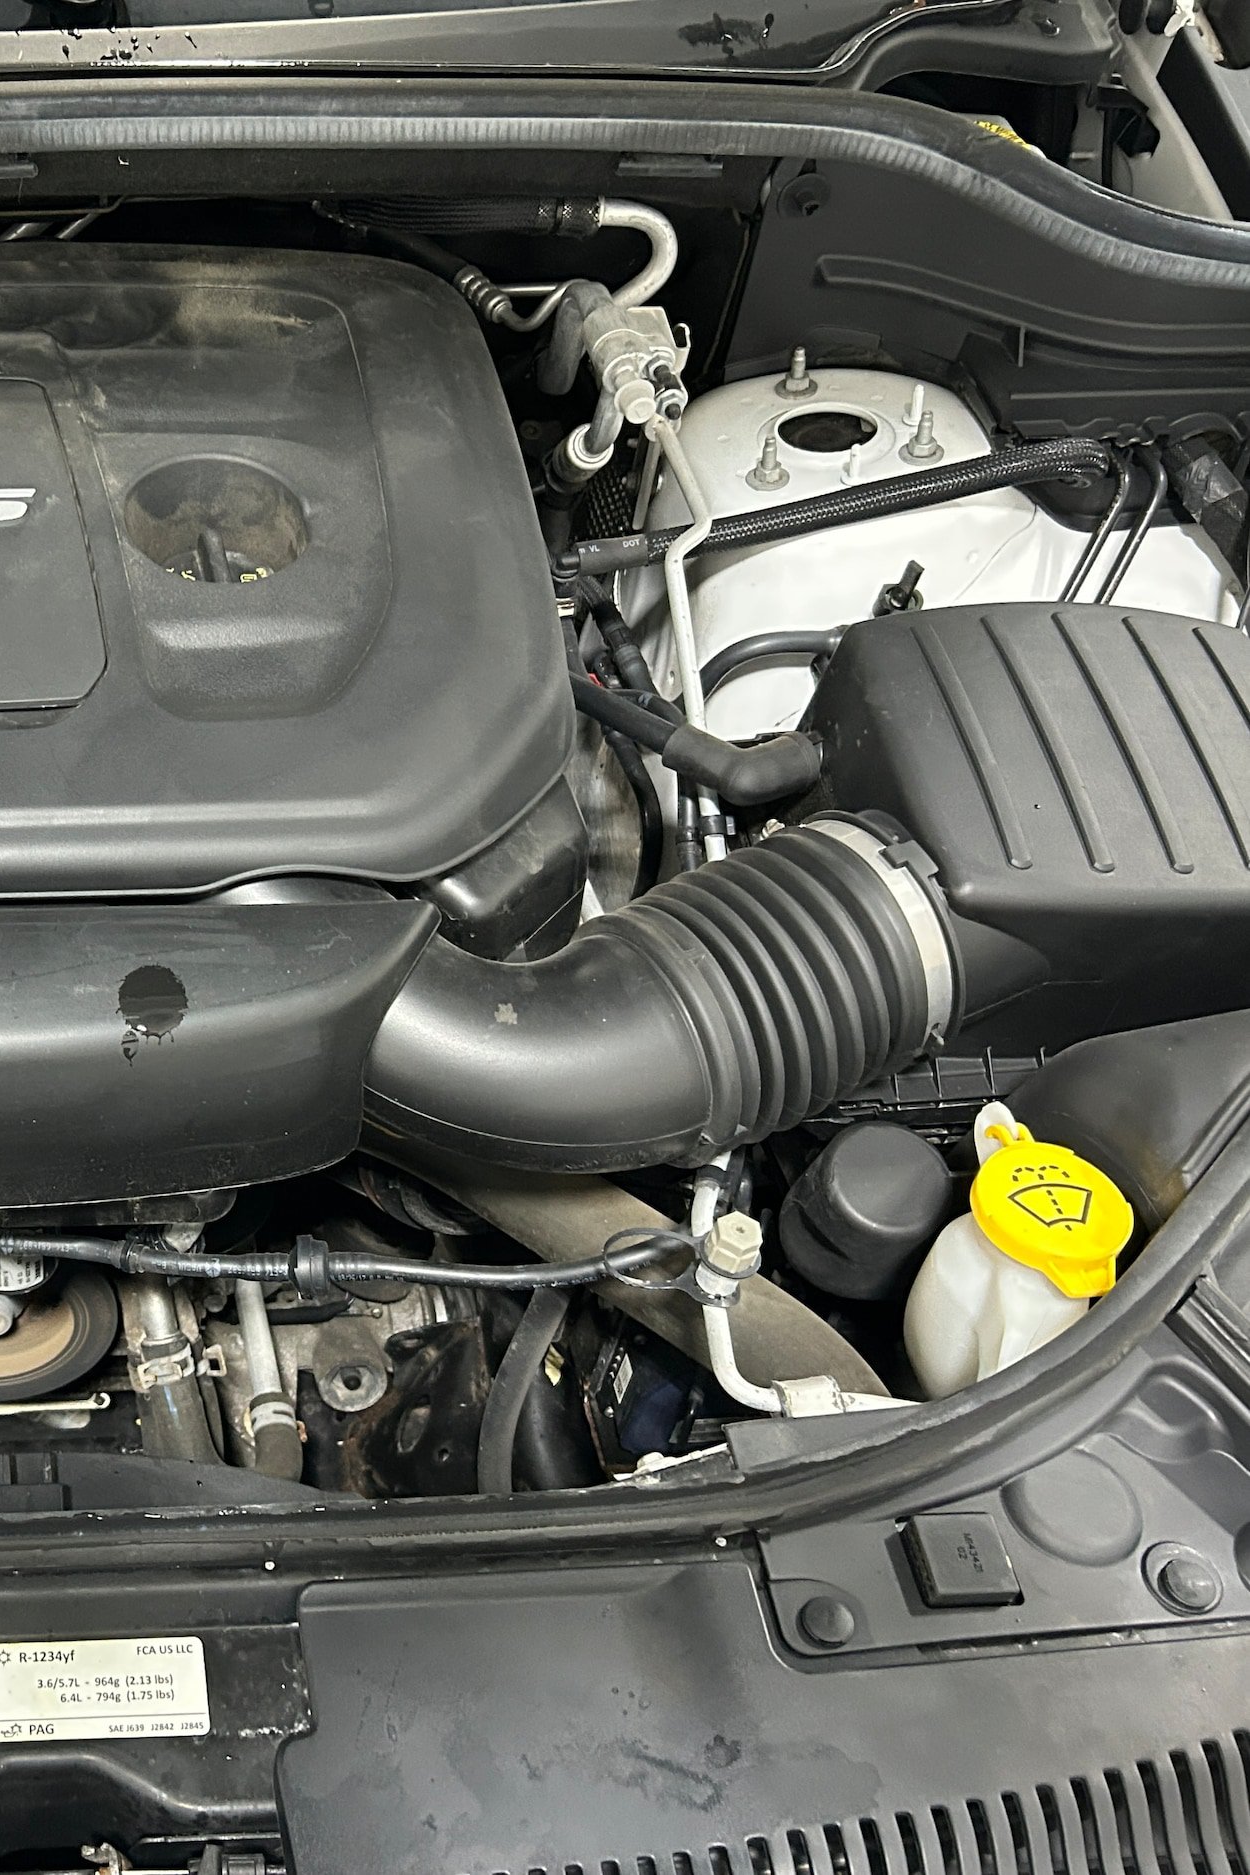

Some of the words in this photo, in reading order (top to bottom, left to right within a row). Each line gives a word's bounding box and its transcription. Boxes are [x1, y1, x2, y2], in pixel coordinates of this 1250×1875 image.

[622, 538, 641, 548] DOT
[136, 1645, 157, 1655] FCA
[159, 1645, 173, 1654] US
[176, 1644, 193, 1653] LLC
[19, 1649, 75, 1664] R-1234yf
[37, 1677, 80, 1690] 3.6/5.7L
[94, 1677, 120, 1688] 964g
[125, 1675, 152, 1688] (2.13
[154, 1673, 174, 1686] lbs)
[60, 1693, 82, 1703] 6.4L
[96, 1692, 121, 1703] 794g
[126, 1690, 153, 1703] (1.75
[155, 1688, 175, 1701] lbs)
[29, 1724, 55, 1735] PAG
[108, 1724, 124, 1733] SAE
[126, 1724, 145, 1732] J639
[151, 1723, 174, 1731] J2842
[180, 1722, 204, 1730] J2845
